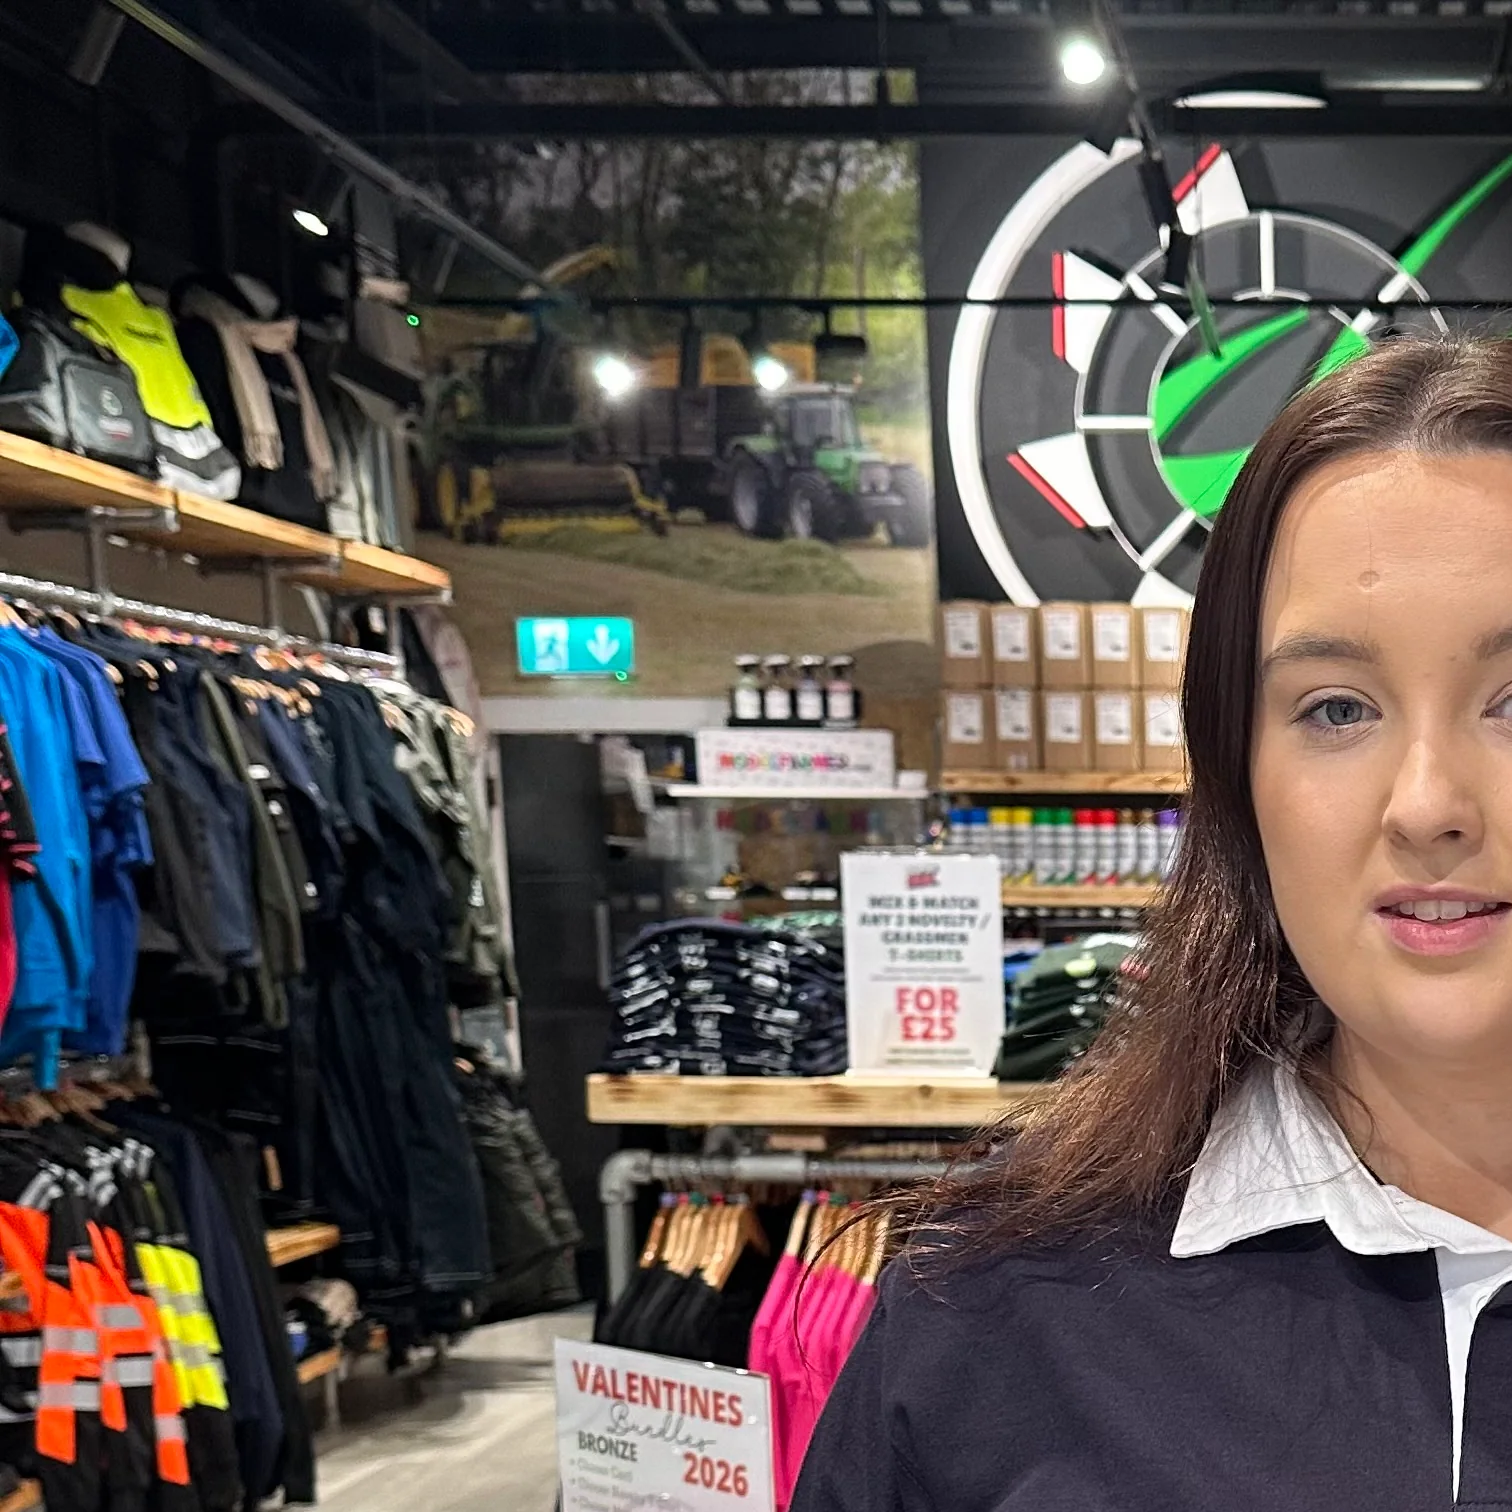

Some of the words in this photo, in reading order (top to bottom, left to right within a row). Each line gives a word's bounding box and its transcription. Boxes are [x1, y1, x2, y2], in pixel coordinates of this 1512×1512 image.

[896, 987, 959, 1014] FOR
[902, 1016, 956, 1042] £25
[572, 1359, 743, 1427] VALENTINES
[607, 1401, 717, 1451] Bundles
[578, 1430, 638, 1462] BRONZE
[683, 1451, 749, 1497] 2026
